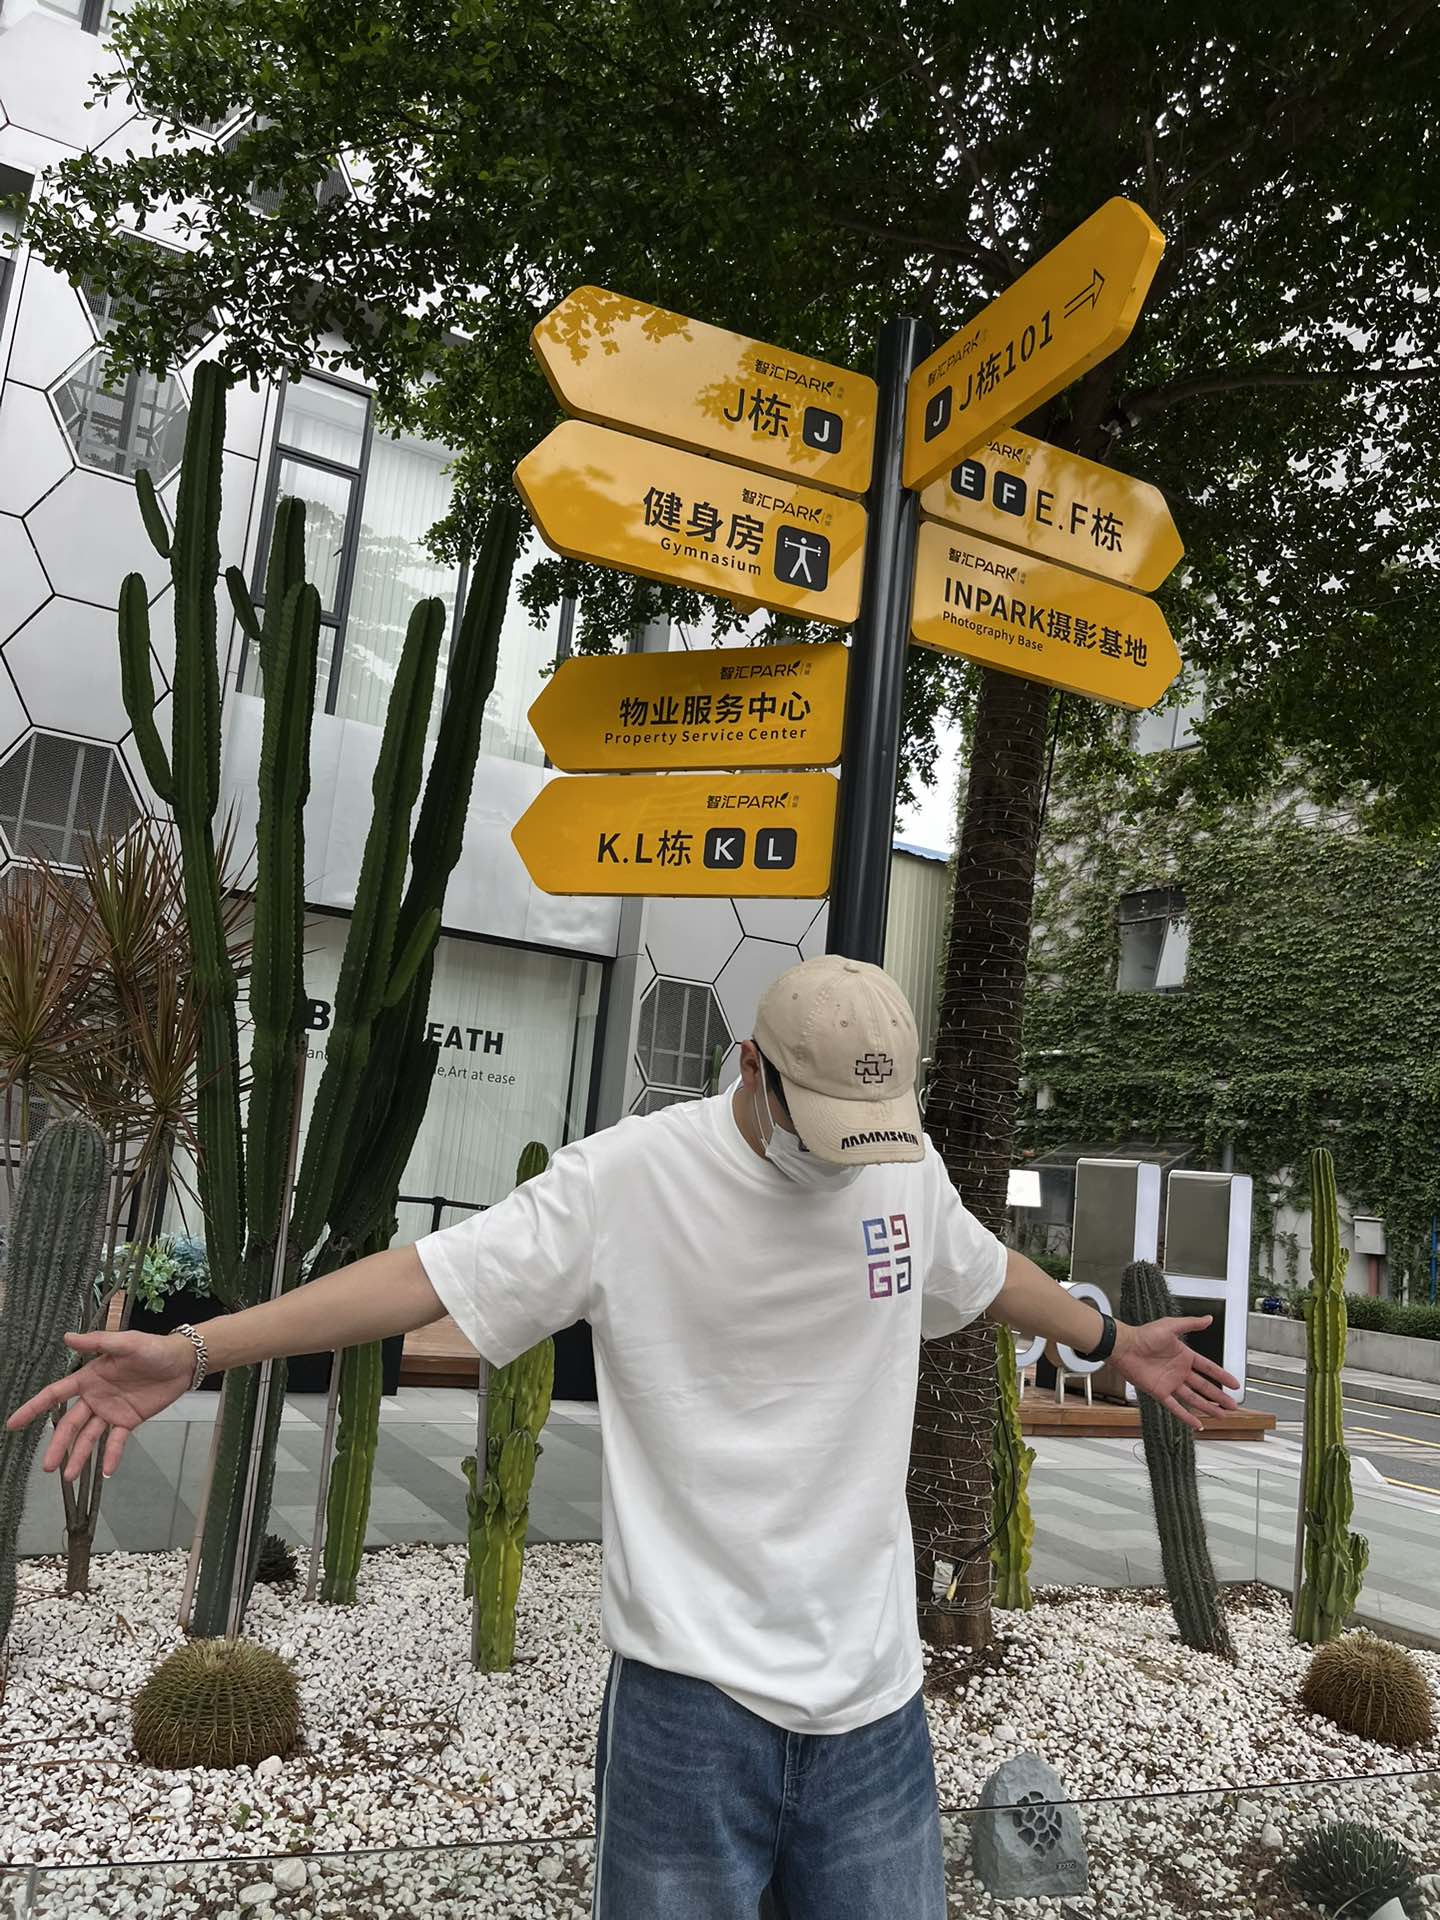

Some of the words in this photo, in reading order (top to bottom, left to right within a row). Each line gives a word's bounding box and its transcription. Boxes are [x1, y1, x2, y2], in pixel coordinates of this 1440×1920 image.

[754, 359, 835, 396] 智汇PARK
[932, 400, 943, 427] J
[959, 310, 1053, 411] J栋101
[723, 388, 792, 438] J栋
[813, 420, 830, 443] J
[643, 487, 765, 556] 健身房
[742, 488, 823, 524] 智汇PARK
[960, 465, 975, 492] E
[1002, 482, 1017, 505] F
[1035, 490, 1124, 553] E.F栋
[660, 537, 762, 577] Gymnasium
[948, 547, 1018, 584] 智汇PARK
[942, 611, 1015, 645] Photography
[1017, 635, 1044, 652] Base
[944, 577, 1149, 668] INPARK摄影基地
[720, 660, 801, 680] 智汇PARK
[619, 691, 811, 727] 物业服务中心
[604, 732, 677, 746] Property
[681, 728, 744, 743] Service
[748, 727, 807, 741] Center
[706, 791, 790, 809] 智汇PARK
[596, 830, 693, 867] K.L栋
[714, 837, 736, 861] K
[766, 837, 783, 861] L
[471, 1069, 484, 1081] at
[487, 1072, 516, 1085] ease
